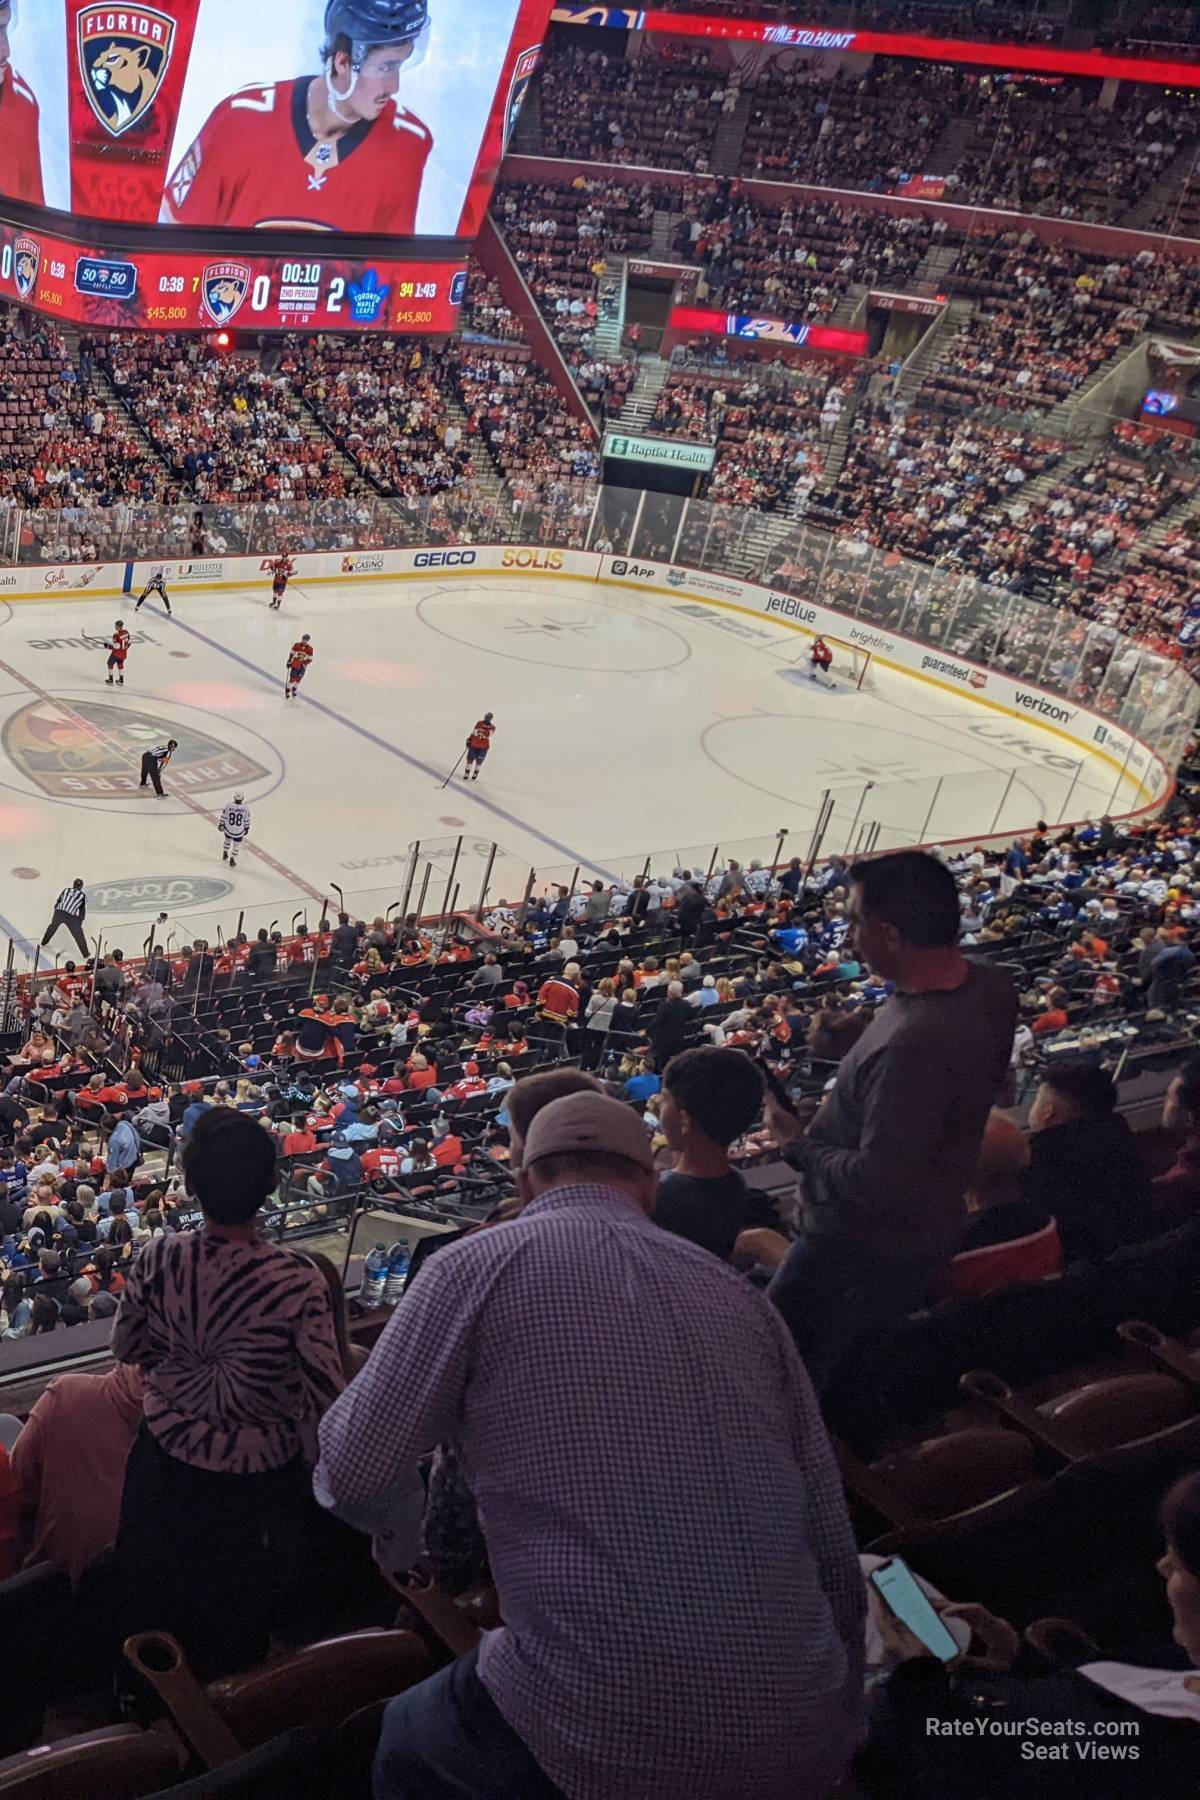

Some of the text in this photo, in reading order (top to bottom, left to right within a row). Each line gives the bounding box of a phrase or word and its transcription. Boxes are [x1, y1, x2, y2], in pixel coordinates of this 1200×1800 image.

[86, 13, 162, 40] FLORIDA
[762, 25, 856, 48] TIME TO HUNT
[1, 244, 12, 279] 0
[82, 268, 127, 285] 50 50
[210, 266, 245, 278] FLORIDA
[282, 263, 321, 283] 00:10
[160, 276, 200, 292] 0:38 7
[252, 275, 270, 311] 0
[281, 289, 317, 298] 2ND PERIOD
[400, 282, 436, 297] 34 1:43
[326, 277, 345, 312] 2
[354, 292, 381, 304] TORONTO
[146, 307, 187, 320] $45,800
[396, 311, 432, 324] $45,800
[630, 442, 707, 464] Baptist Health
[355, 560, 384, 569] CASINO
[414, 551, 476, 567] GEICO
[501, 549, 564, 569] SOLIS
[765, 592, 816, 624] jetBlue
[850, 628, 895, 653] brightline
[921, 655, 970, 681] guaranteed
[1015, 691, 1069, 723] verizon
[968, 724, 1081, 769] UKG
[228, 813, 244, 827] 88
[96, 877, 195, 909] Ford
[302, 947, 315, 962] 16
